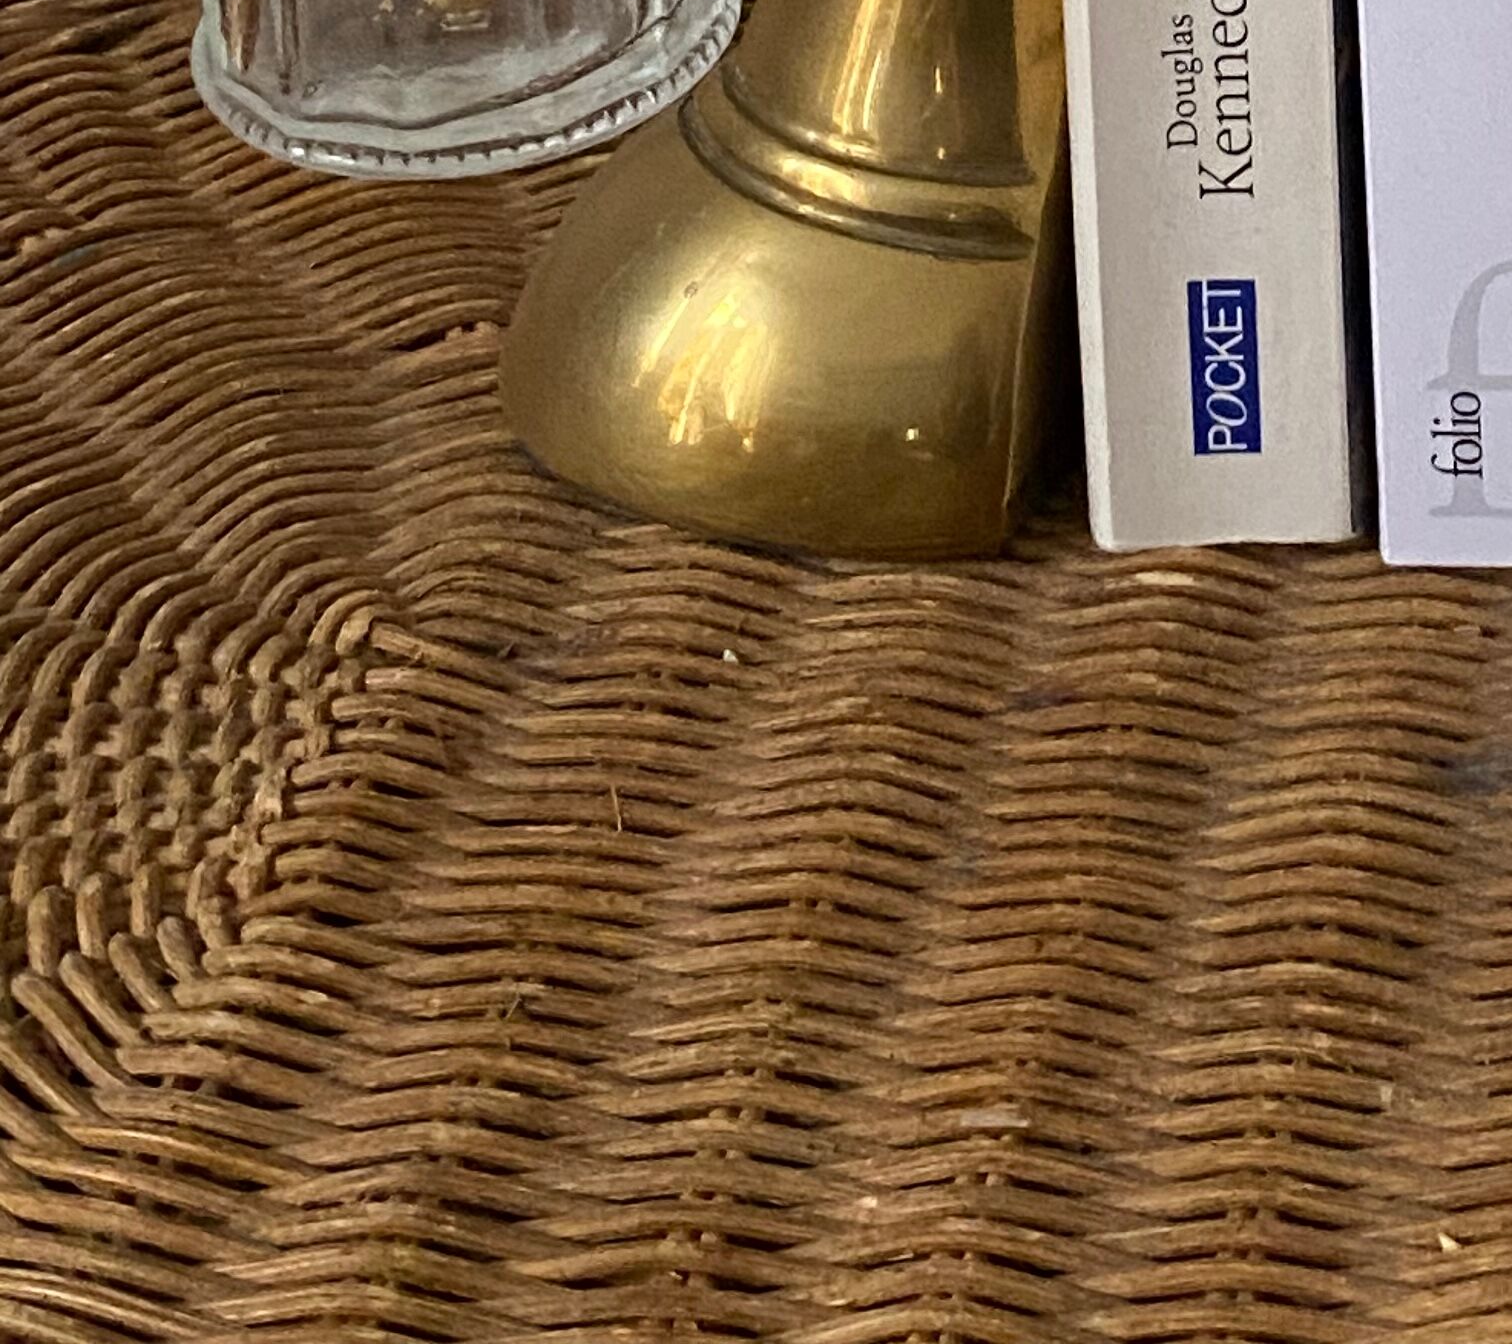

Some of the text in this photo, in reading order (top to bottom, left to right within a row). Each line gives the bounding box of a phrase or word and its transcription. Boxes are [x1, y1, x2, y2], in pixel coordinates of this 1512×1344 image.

[1160, 14, 1204, 150] Douglas
[1202, 280, 1248, 453] POCKET
[1430, 391, 1484, 480] folio
